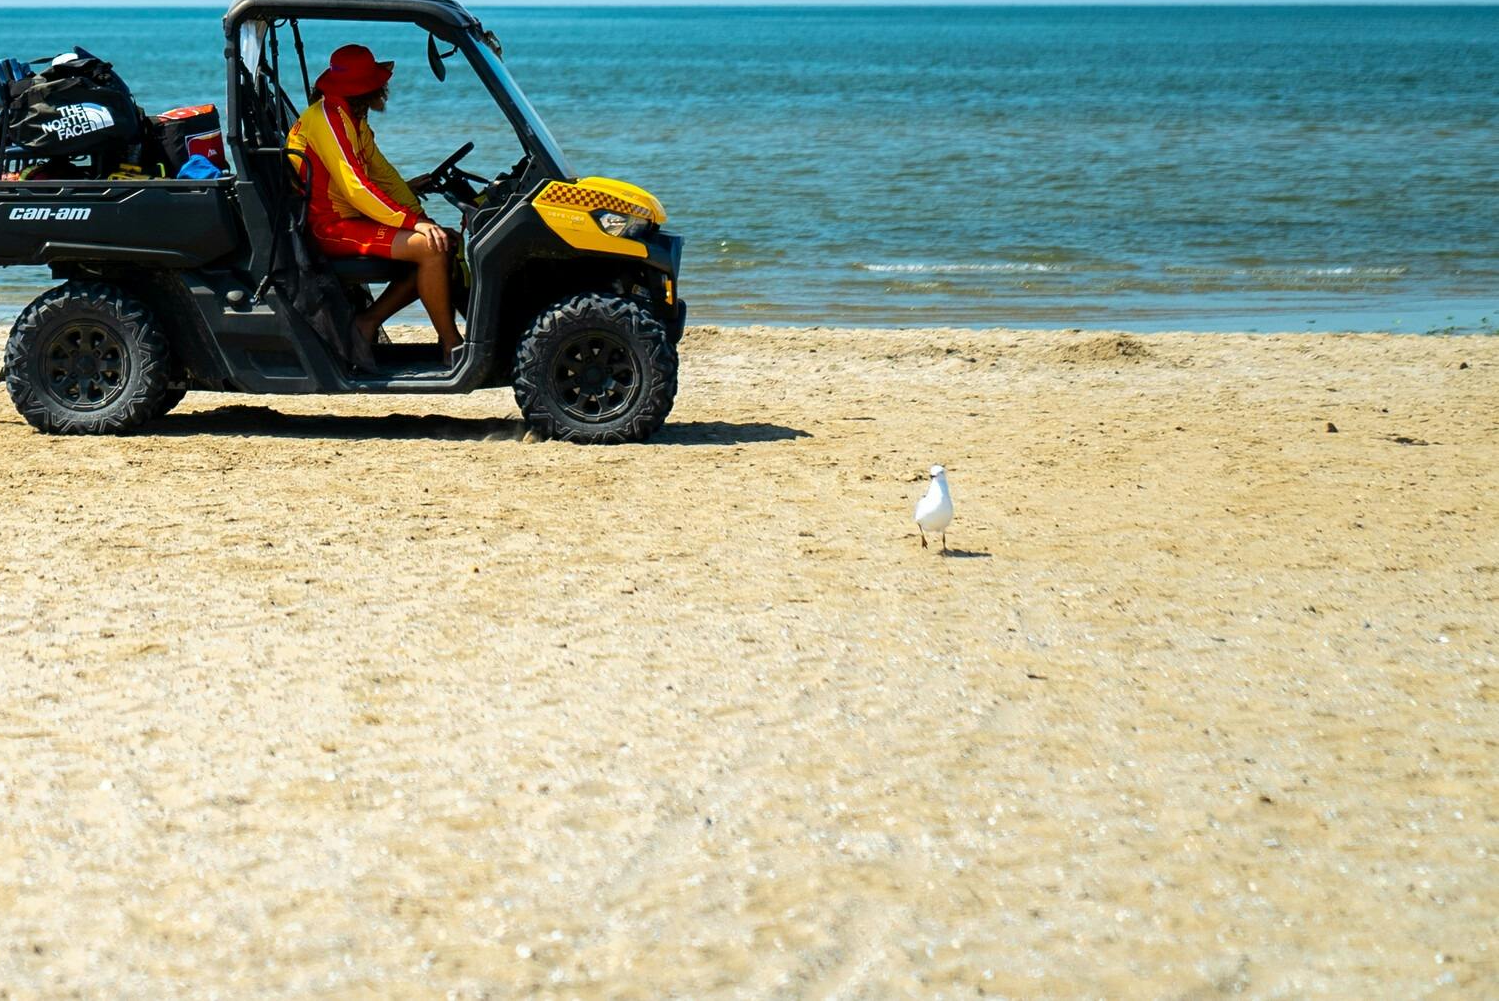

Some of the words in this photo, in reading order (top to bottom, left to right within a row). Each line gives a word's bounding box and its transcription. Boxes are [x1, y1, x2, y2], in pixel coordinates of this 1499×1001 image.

[56, 103, 83, 117] THE
[41, 112, 88, 134] NORTH
[57, 121, 91, 141] FACE
[9, 207, 92, 220] can-am
